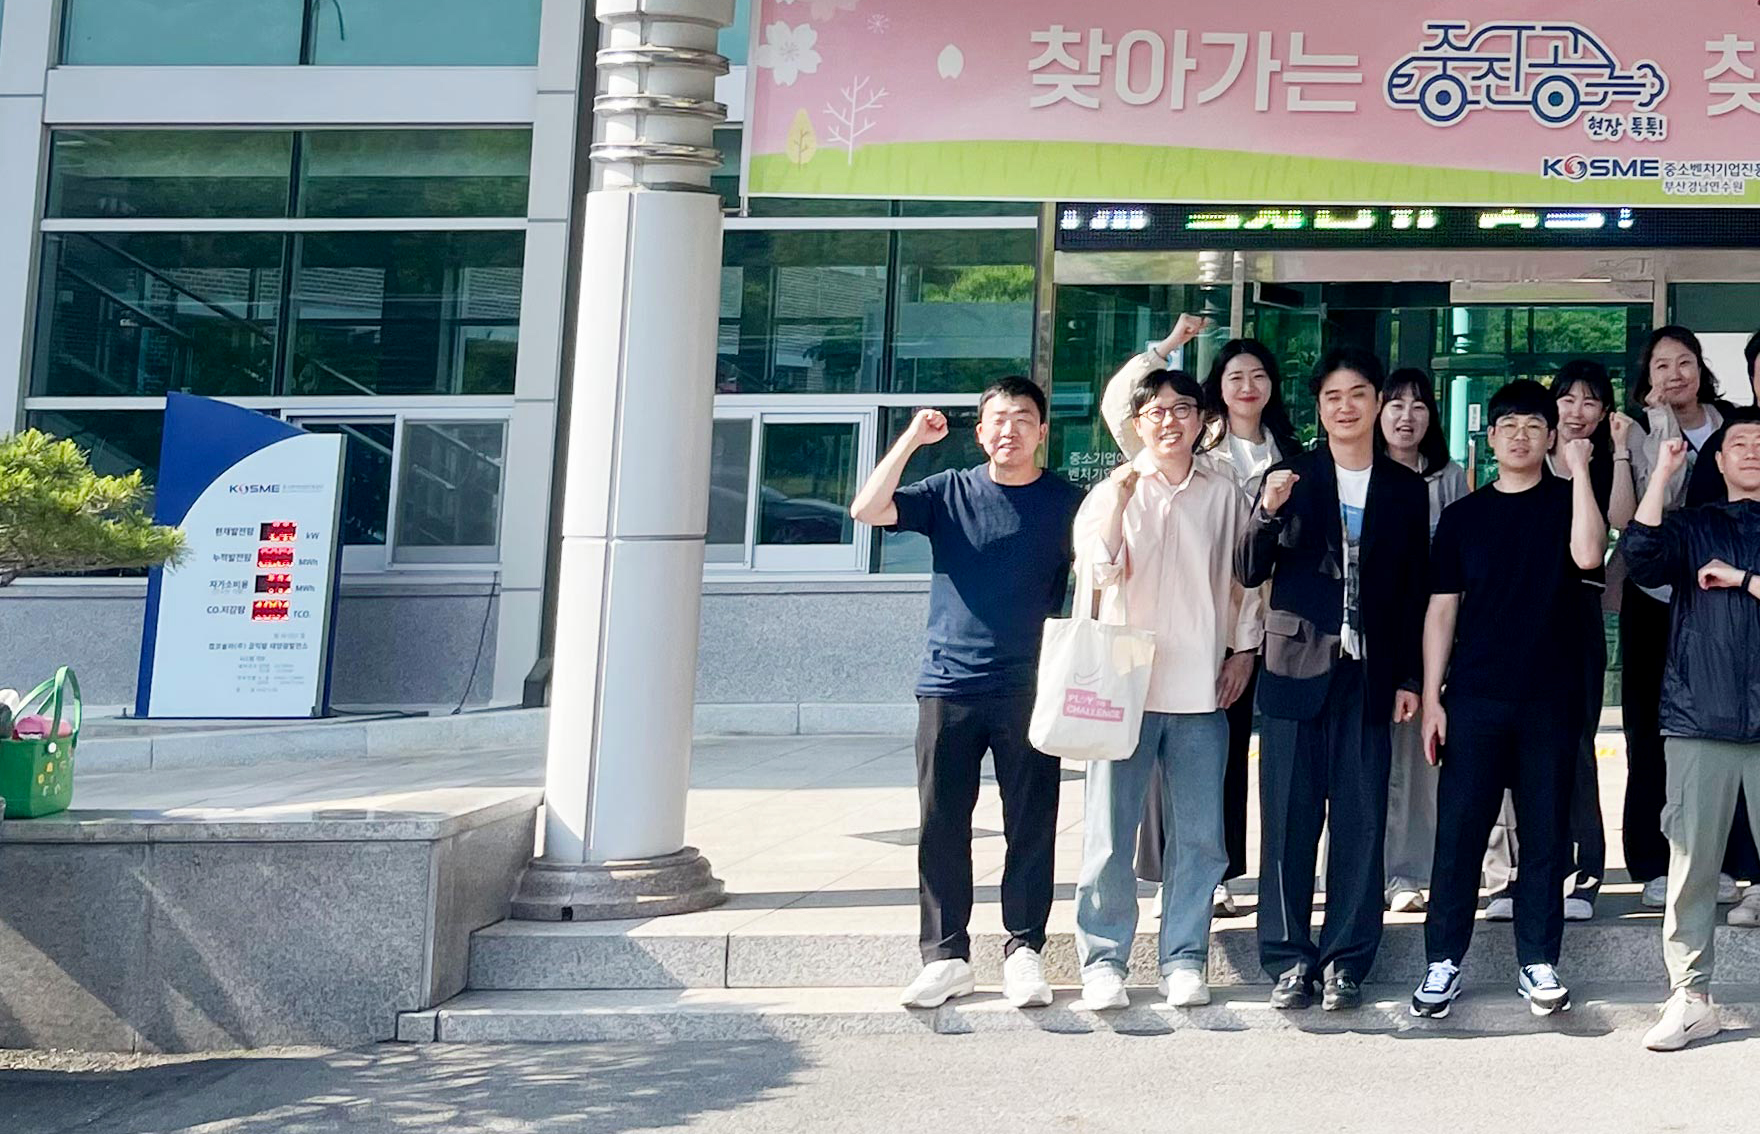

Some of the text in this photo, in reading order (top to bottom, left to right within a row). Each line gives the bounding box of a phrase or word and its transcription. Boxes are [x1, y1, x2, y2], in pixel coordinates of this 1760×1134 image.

[1027, 23, 1363, 112] 찾아가는
[1588, 116, 1663, 137] 현장 톡톡!
[1543, 155, 1659, 180] KOSME
[1664, 180, 1744, 193] 부산경남연수원
[229, 483, 280, 495] KOSME
